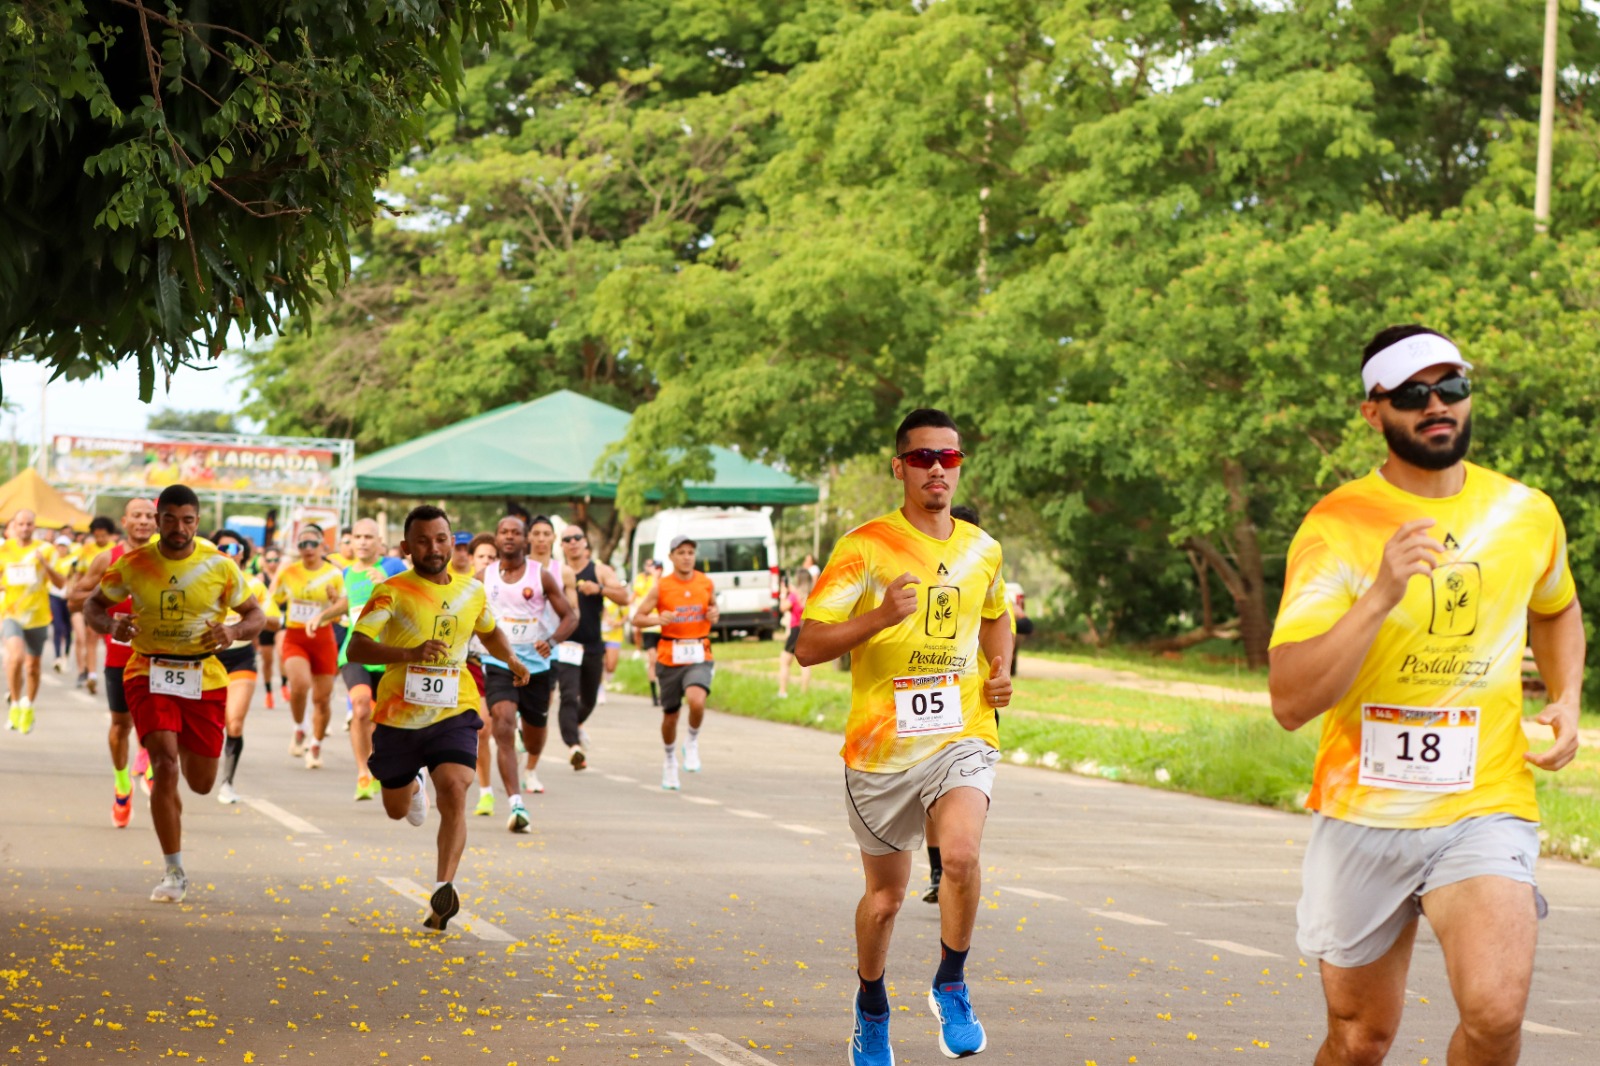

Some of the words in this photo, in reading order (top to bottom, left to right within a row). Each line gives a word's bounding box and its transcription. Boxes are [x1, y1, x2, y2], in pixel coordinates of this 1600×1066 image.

[208, 450, 319, 471] LARGADA
[512, 624, 527, 635] 67
[908, 650, 968, 667] Pestalozzi
[1400, 654, 1493, 676] Pestalozzi
[165, 670, 185, 685] 85
[421, 677, 444, 693] 30
[1412, 676, 1451, 686] Senador
[911, 691, 944, 716] 05
[1396, 731, 1441, 763] 18
